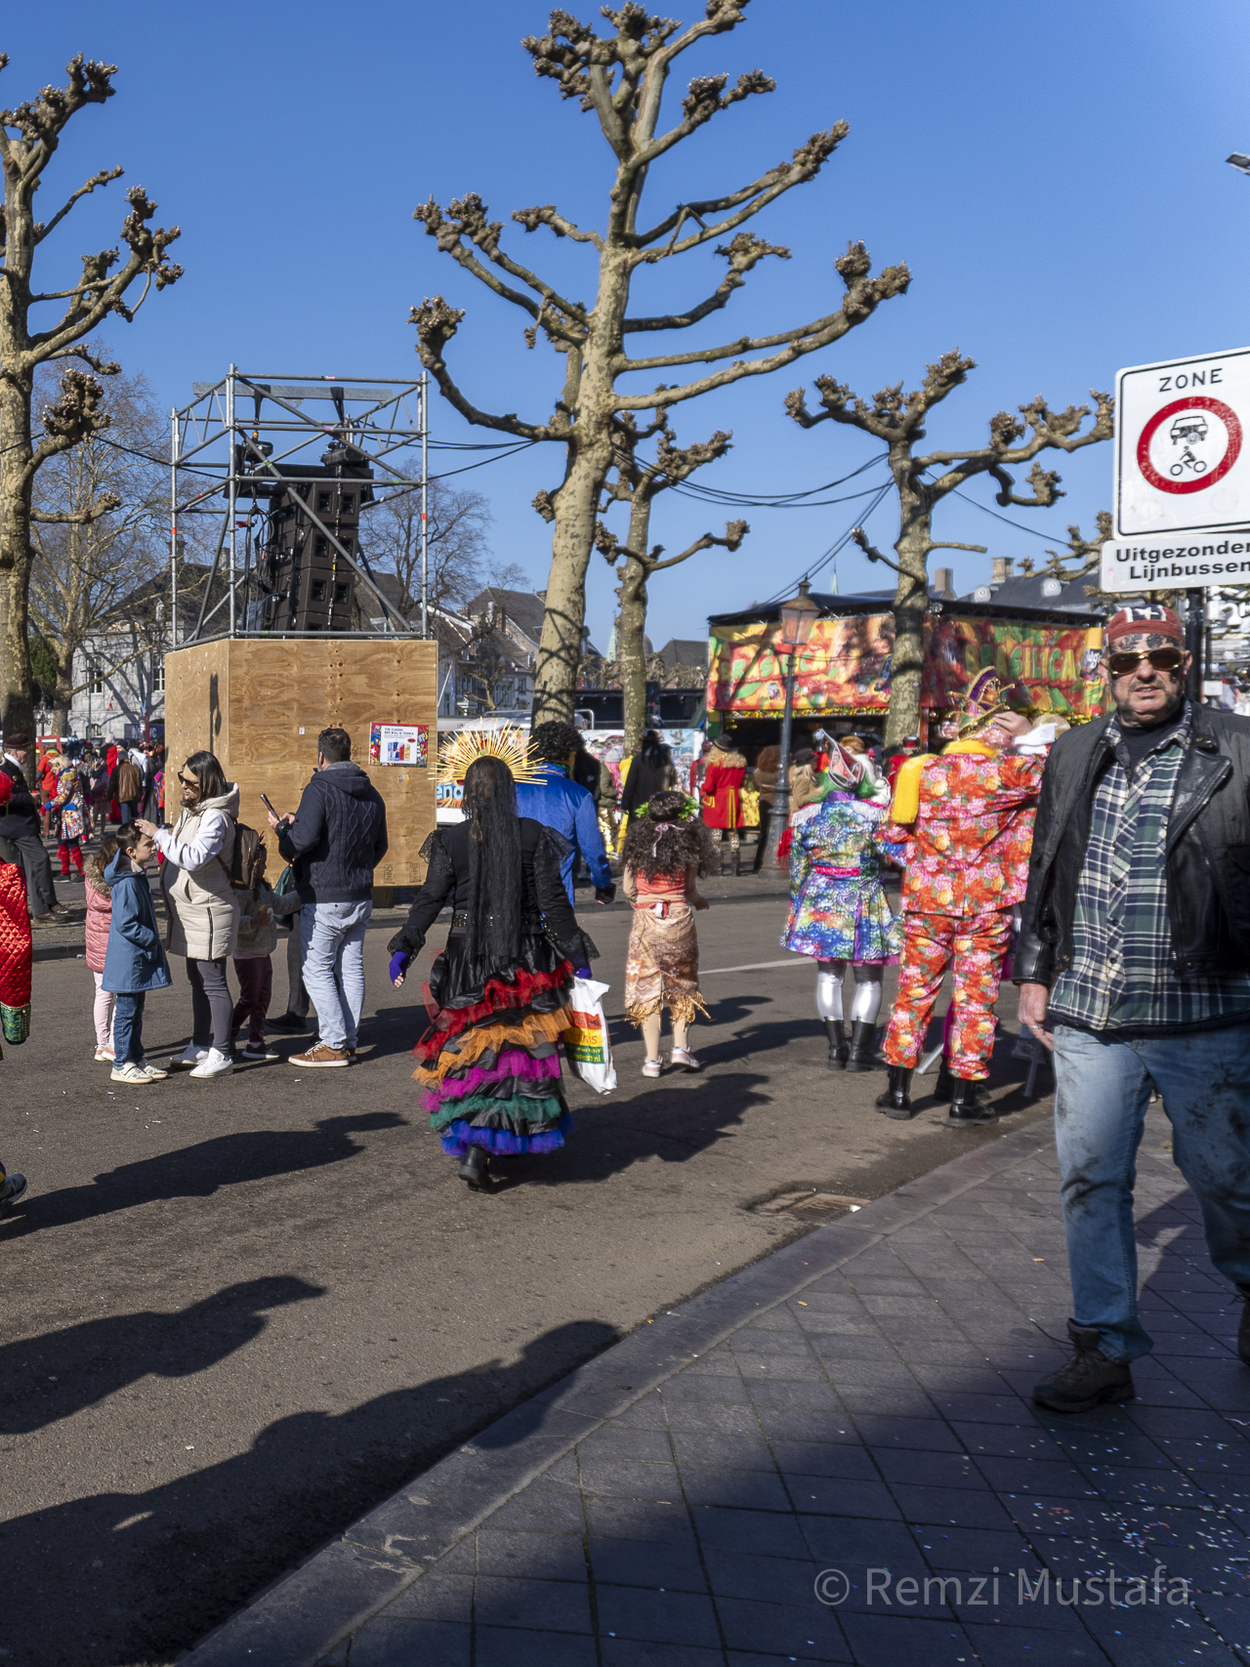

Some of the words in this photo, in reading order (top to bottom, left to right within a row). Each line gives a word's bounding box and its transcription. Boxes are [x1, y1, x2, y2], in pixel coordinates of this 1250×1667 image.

[1158, 367, 1223, 392] ZONE
[1130, 561, 1250, 582] Lijnbussen
[965, 644, 1077, 682] BRASILICA
